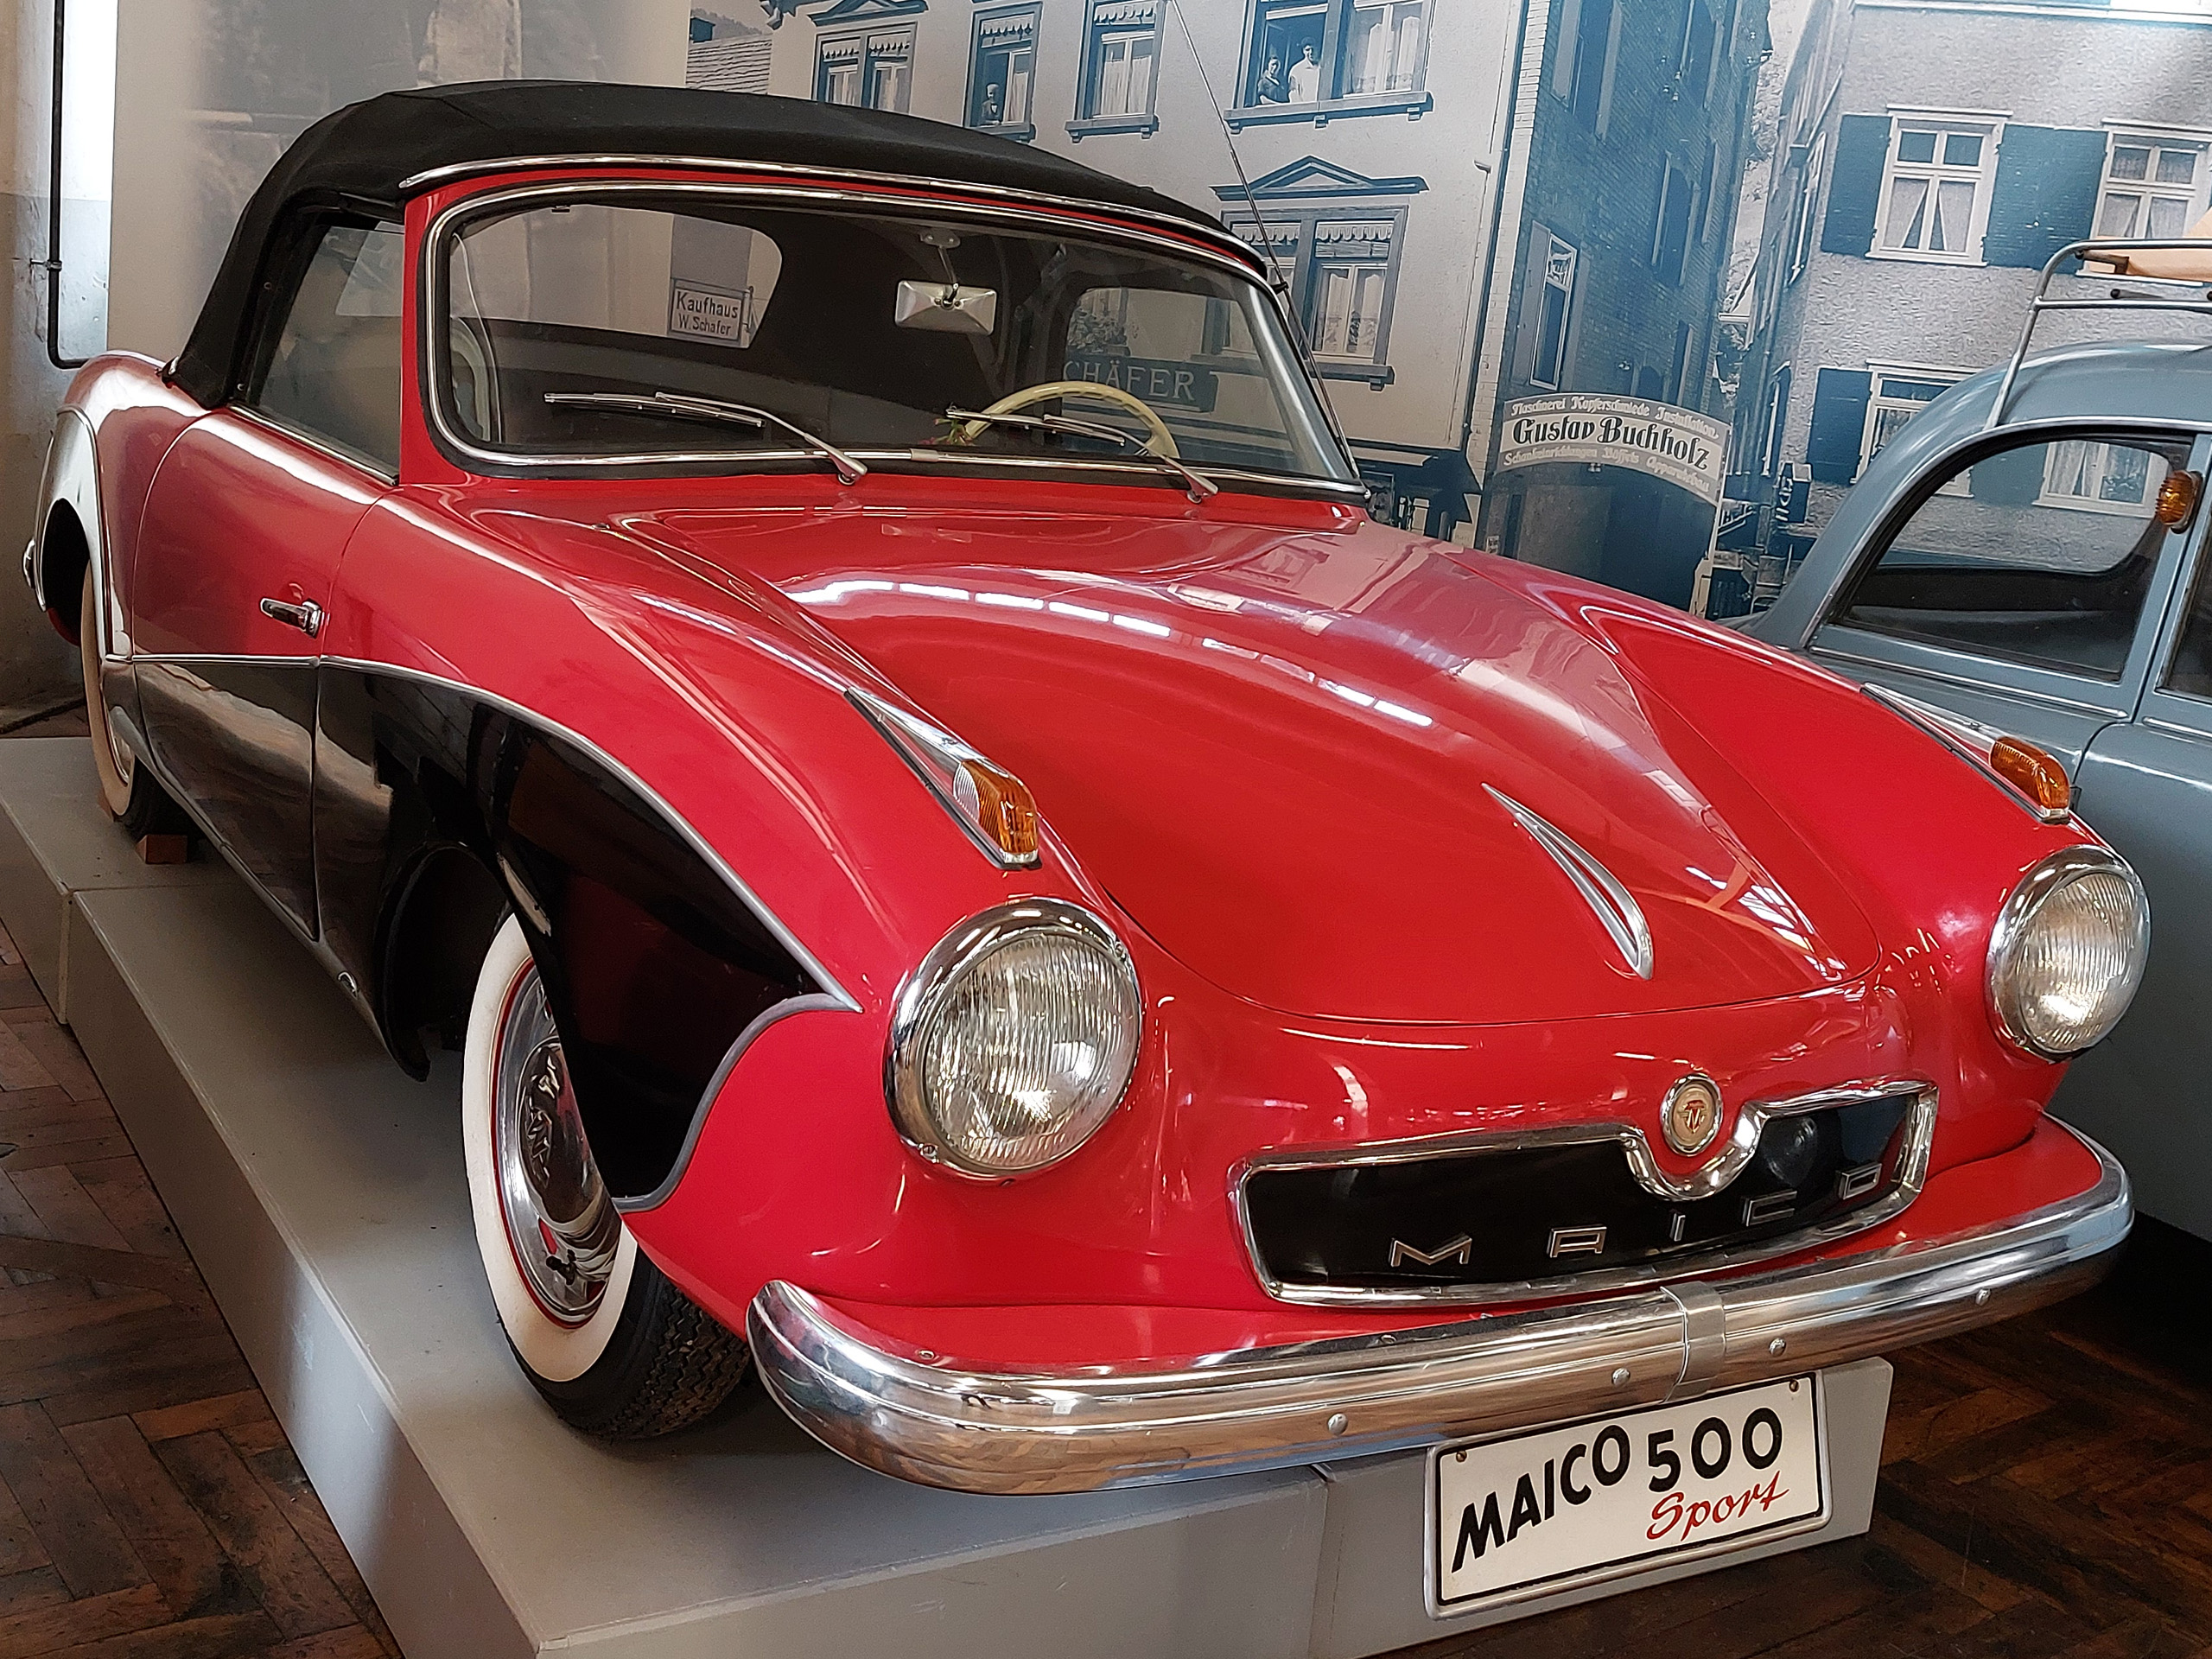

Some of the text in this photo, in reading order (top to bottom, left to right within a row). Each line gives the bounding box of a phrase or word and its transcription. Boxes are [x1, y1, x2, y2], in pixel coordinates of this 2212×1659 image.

[677, 291, 738, 319] Kaufhaus
[1513, 416, 1710, 470] Gustav Buchholz
[1389, 1162, 1883, 1268] MAICO
[1451, 1407, 1783, 1573] MAICO 500
[1646, 1471, 1790, 1541] Sport
